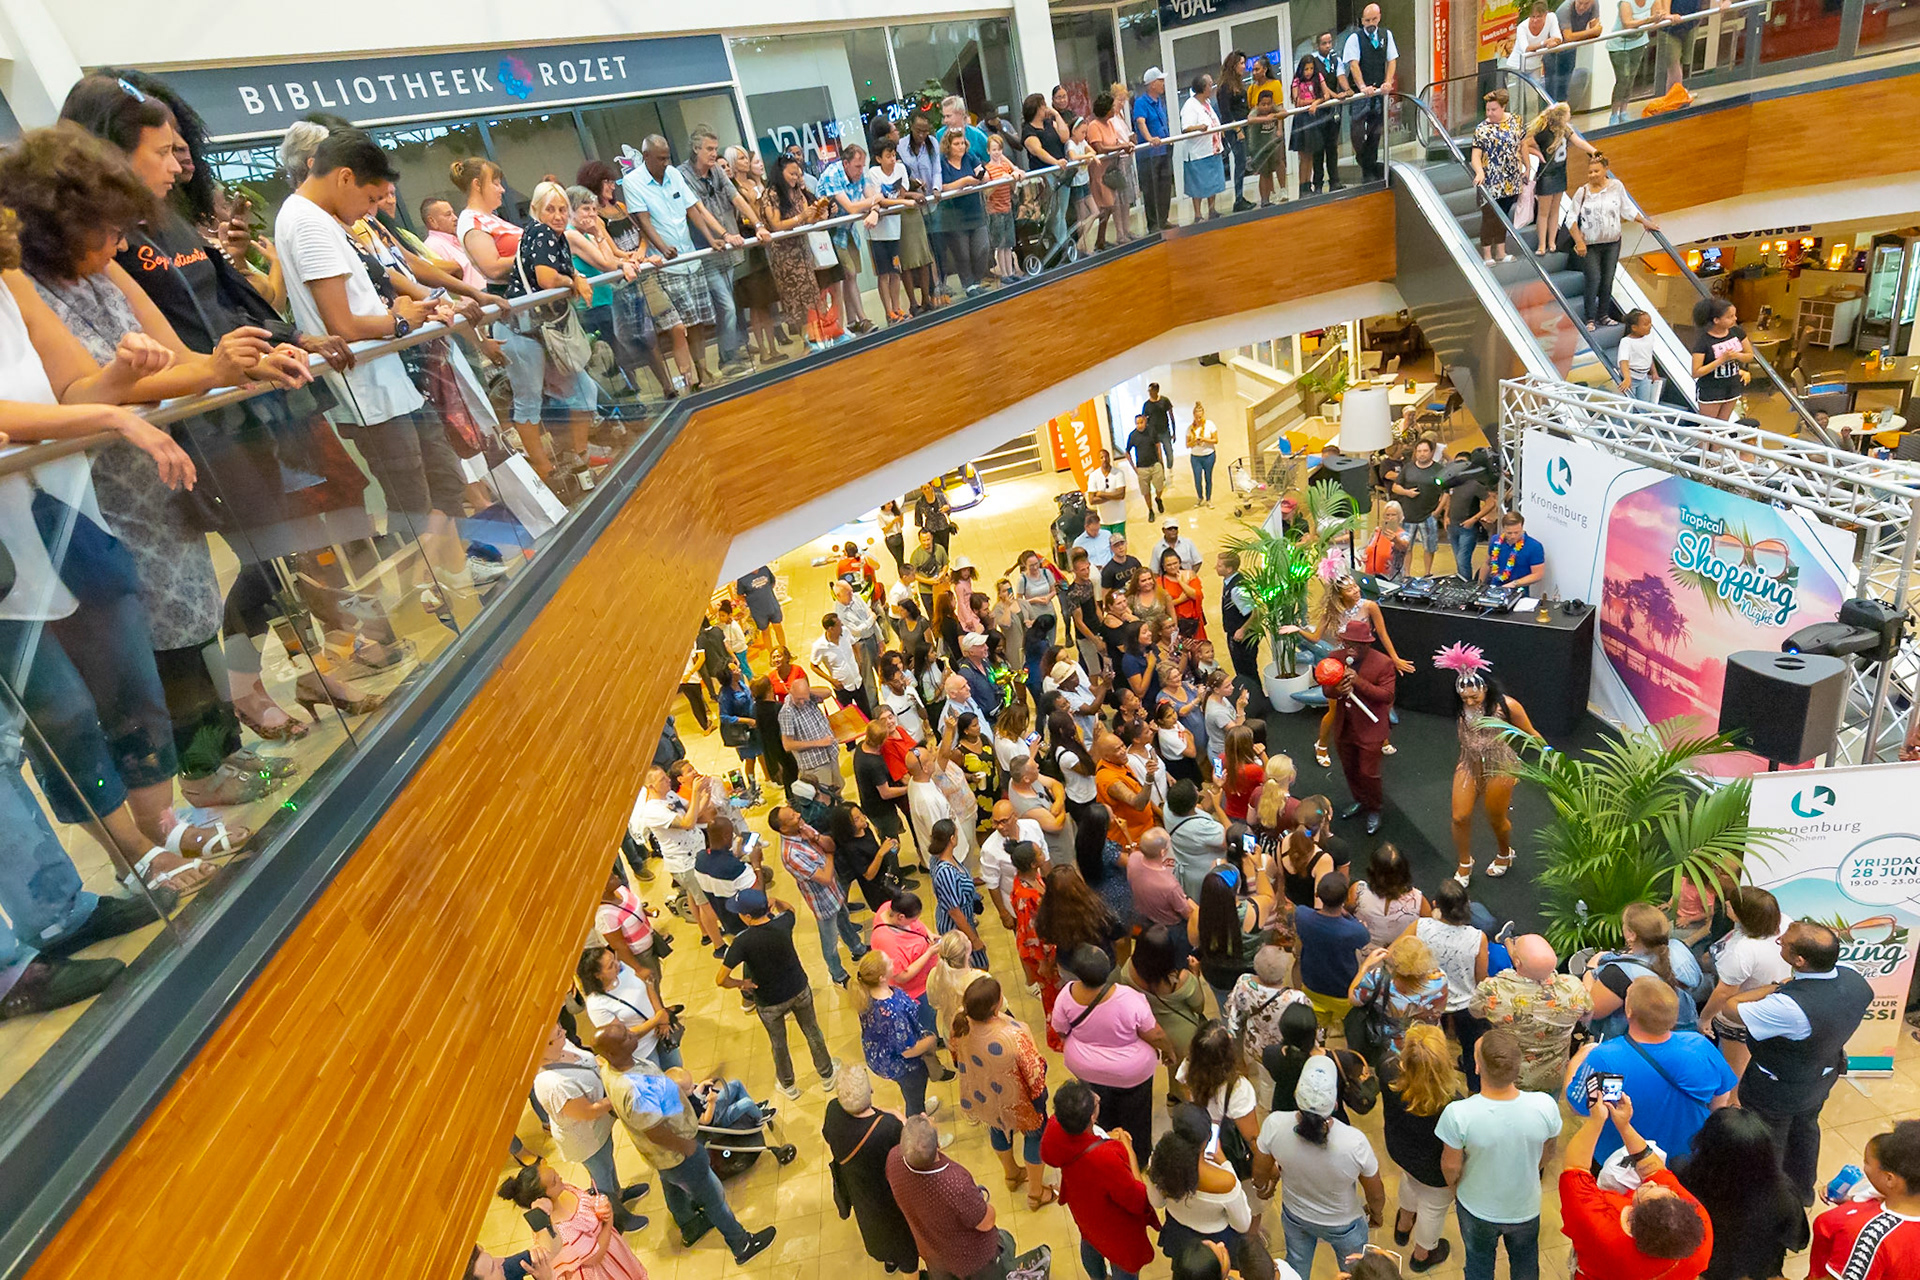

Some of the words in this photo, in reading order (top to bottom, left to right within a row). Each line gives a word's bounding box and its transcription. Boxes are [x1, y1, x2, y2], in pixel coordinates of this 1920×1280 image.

[238, 67, 494, 115] BIBLIOTHEEK
[538, 56, 627, 87] ROZET
[1530, 492, 1588, 529] Kronenburg
[1547, 513, 1568, 528] Arnhem
[1680, 508, 1723, 535] Tropical
[1115, 566, 1138, 580] GUCC
[1674, 532, 1797, 625] Shopping
[1741, 598, 1774, 626] Night
[1850, 879, 1879, 887] 19.00
[1851, 868, 1873, 878] 28
